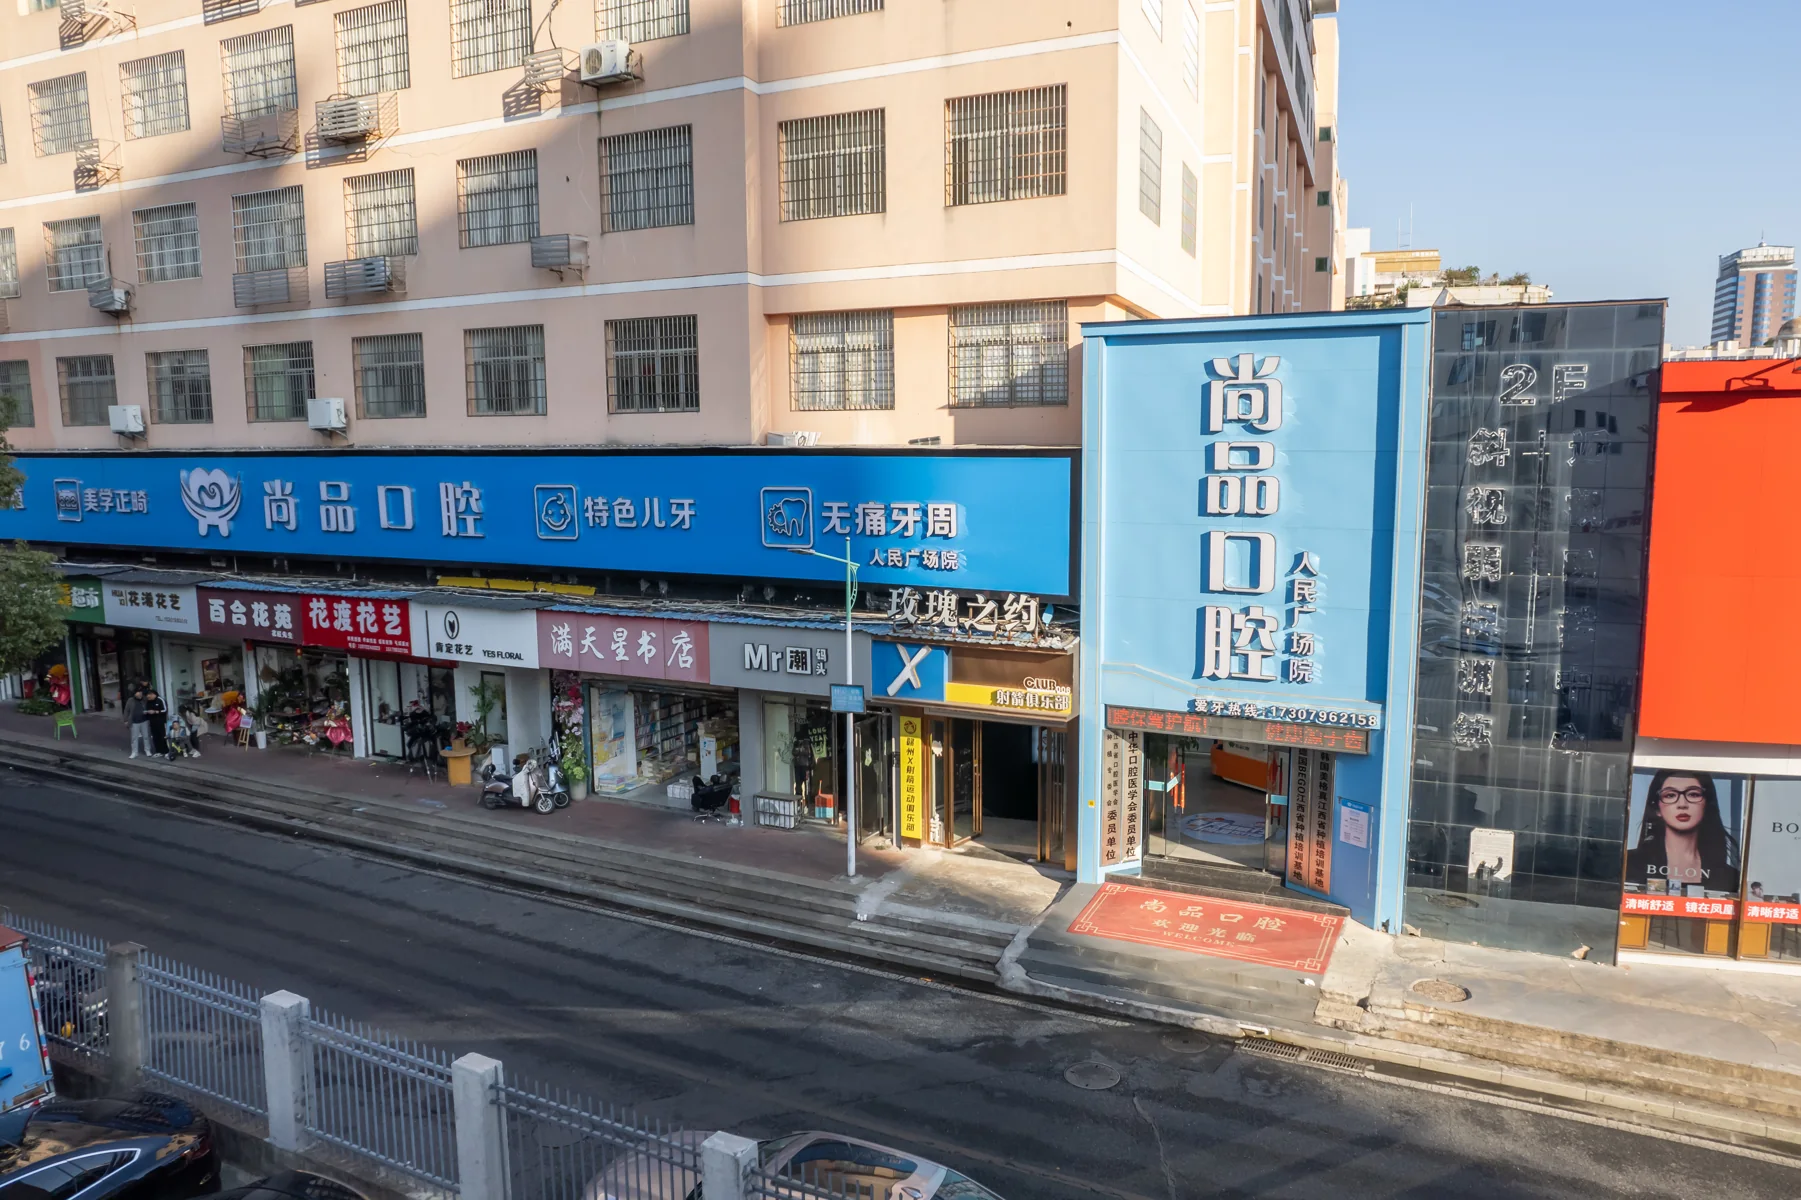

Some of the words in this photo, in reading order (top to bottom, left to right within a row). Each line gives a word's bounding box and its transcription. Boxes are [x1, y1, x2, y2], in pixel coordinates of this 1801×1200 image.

[1499, 363, 1588, 406] 2F
[83, 488, 148, 513] 美学正畸
[263, 479, 485, 538] 尚品口腔
[584, 497, 696, 530] 特色儿牙
[821, 501, 958, 538] 无痛牙周
[1202, 353, 1282, 681] 尚品口腔
[869, 547, 959, 570] 人民广场院
[208, 598, 292, 629] 百合花苑
[887, 586, 1038, 632] 玫瑰之约
[1289, 551, 1318, 683] 人民广场院
[435, 641, 473, 656] 肯定花艺
[482, 649, 496, 659] YES
[497, 651, 524, 661] FLORAL
[551, 622, 693, 669] 满天星书店
[744, 643, 782, 672] Mr
[786, 646, 814, 675] 潮
[815, 648, 828, 676] 码头
[995, 690, 1070, 710] 射箭俱乐部
[1126, 731, 1139, 858] 中华口腔医学会委员单位
[1105, 809, 1117, 860] 委员单位
[1772, 821, 1799, 834] BO
[1646, 864, 1711, 879] BOLON
[1139, 899, 1287, 932] 尚品口腔
[1625, 898, 1675, 912] 清晰舒适
[1685, 901, 1735, 915] 镜在凤凰
[1747, 905, 1799, 918] 清晰舒适
[1151, 918, 1256, 943] 欢迎光临
[1163, 930, 1236, 948] WELCOME
